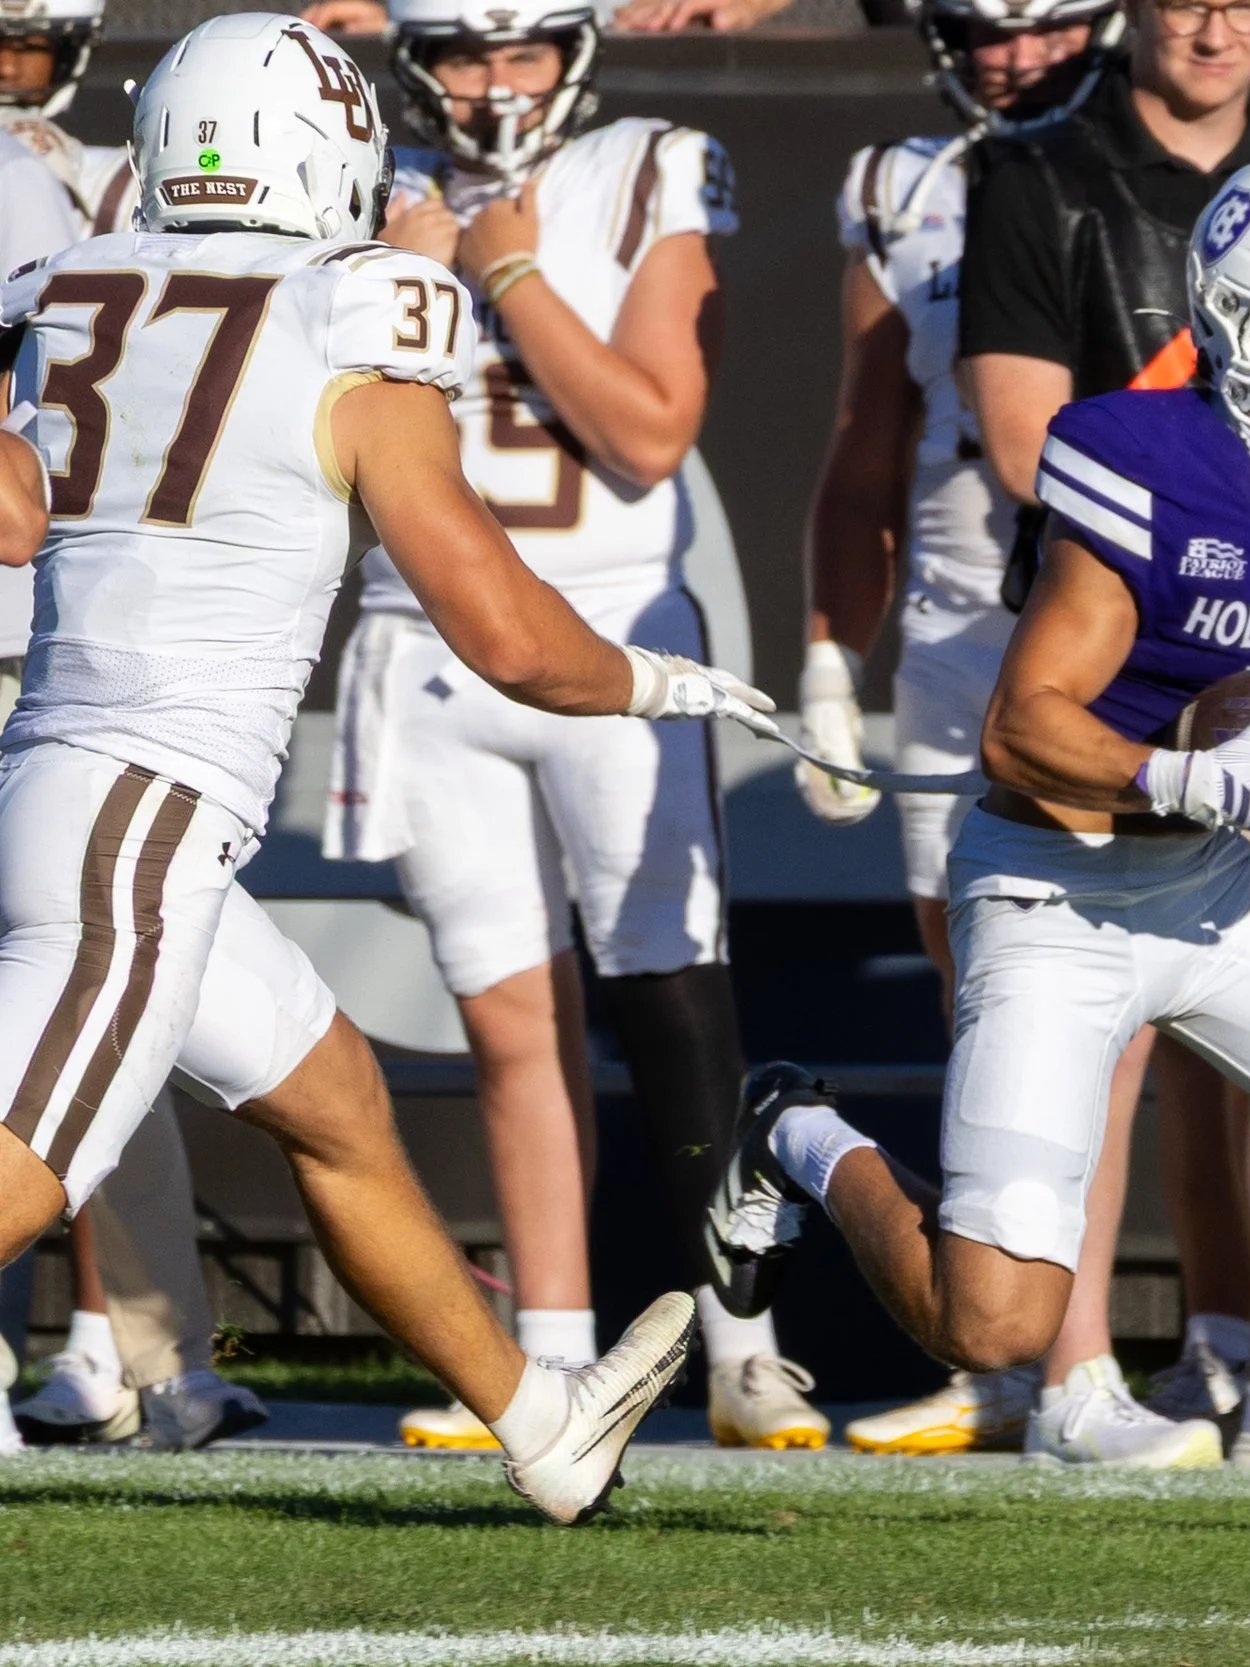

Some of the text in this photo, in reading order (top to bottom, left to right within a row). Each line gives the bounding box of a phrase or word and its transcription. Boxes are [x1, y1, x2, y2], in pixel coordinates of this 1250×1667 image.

[198, 120, 218, 144] 37
[171, 182, 247, 198] THE NEST
[390, 275, 461, 360] 37
[26, 268, 285, 529] 37
[1178, 566, 1245, 581] LEAGUE
[1179, 555, 1248, 572] PATRIOT
